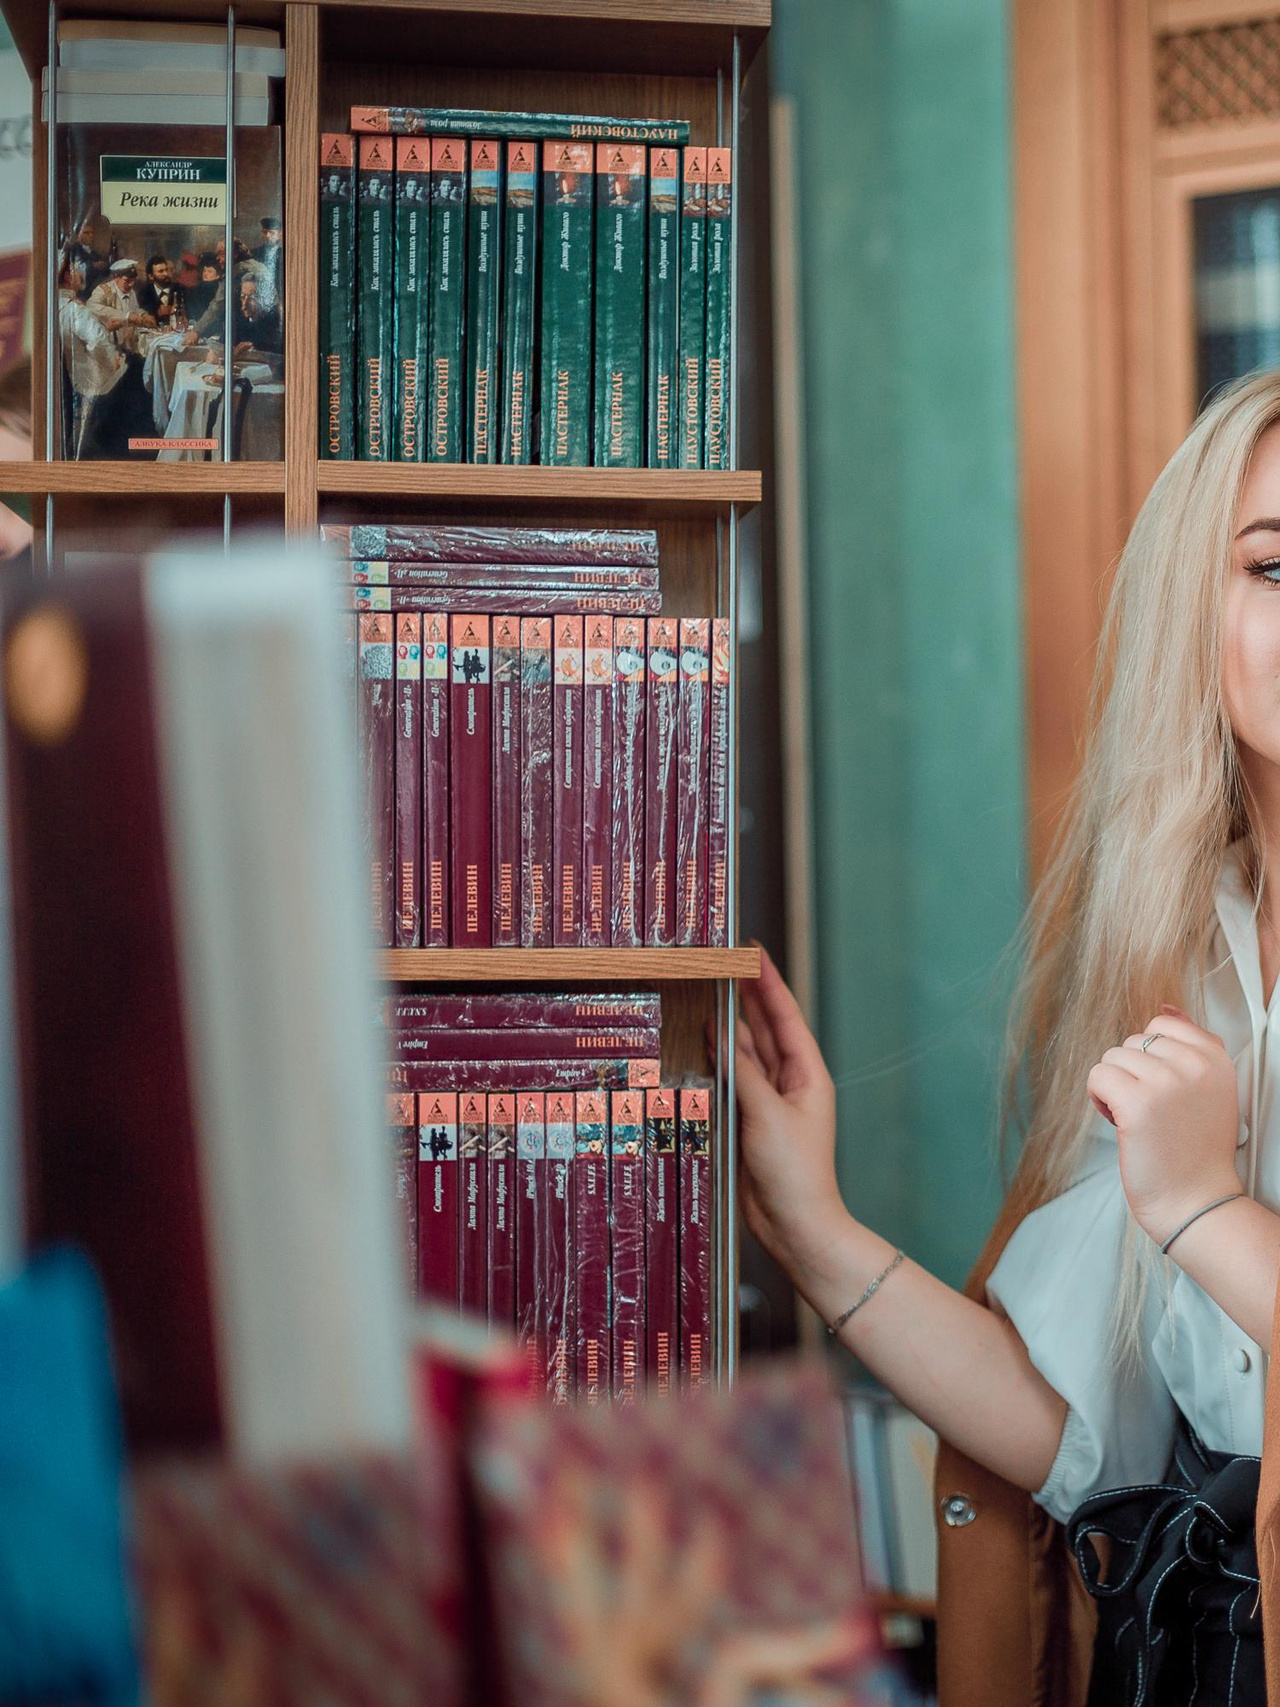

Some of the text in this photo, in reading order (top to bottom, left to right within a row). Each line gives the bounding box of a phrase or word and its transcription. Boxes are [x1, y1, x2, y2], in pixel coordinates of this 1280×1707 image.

[570, 124, 678, 140] ПАУСТОВСКИЙ
[136, 168, 200, 180] КУПРИН
[119, 191, 219, 209] Река жизни
[330, 273, 339, 287] Как
[371, 276, 380, 291] Как
[407, 276, 416, 292] Как
[440, 277, 449, 292] Как
[328, 354, 341, 453] ОСТРОВСКИЙ
[368, 357, 381, 457] ОСТРОВСКИЙ
[403, 358, 416, 457] ОСТРОВСКИЙ
[436, 358, 449, 457] ОСТРОВСКИЙ
[475, 368, 488, 455] ПАСТЕРНАК
[511, 370, 524, 457] ПАСТЕРНАК
[557, 370, 570, 456] ПАСТЕРНАК
[610, 371, 624, 457] ПАСТЕРНАК
[657, 374, 669, 460] ПАСТЕРНАК
[686, 358, 699, 464] ПАУСТОВСКИЙ
[708, 358, 721, 464] ПАУСТОВСКИЙ
[408, 569, 448, 579] Generation
[573, 572, 642, 584] ПЕЛЕВИН
[412, 595, 451, 605] Generation
[576, 597, 646, 610] ПЕЛЕВИН
[404, 699, 413, 738] Generation
[431, 698, 440, 738] Generation
[402, 861, 413, 930] ПЕЛЕВИН
[431, 860, 442, 929] ПЕЛЕВИН
[467, 864, 478, 933] ПЕЛЕВИН
[500, 862, 512, 931] ПЕЛЕВИН
[562, 864, 573, 932] ПЕЛЕВИН
[591, 864, 602, 932] ПЕЛЕВИН
[575, 1005, 644, 1016] ПЕЛЕВИН
[402, 1039, 429, 1050] Empire
[575, 1036, 644, 1048] ПЕЛЕВИН
[555, 1068, 579, 1078] Empire
[433, 1165, 444, 1213] Смотритель
[467, 1205, 477, 1230] Лампа
[496, 1206, 506, 1231] Лампа
